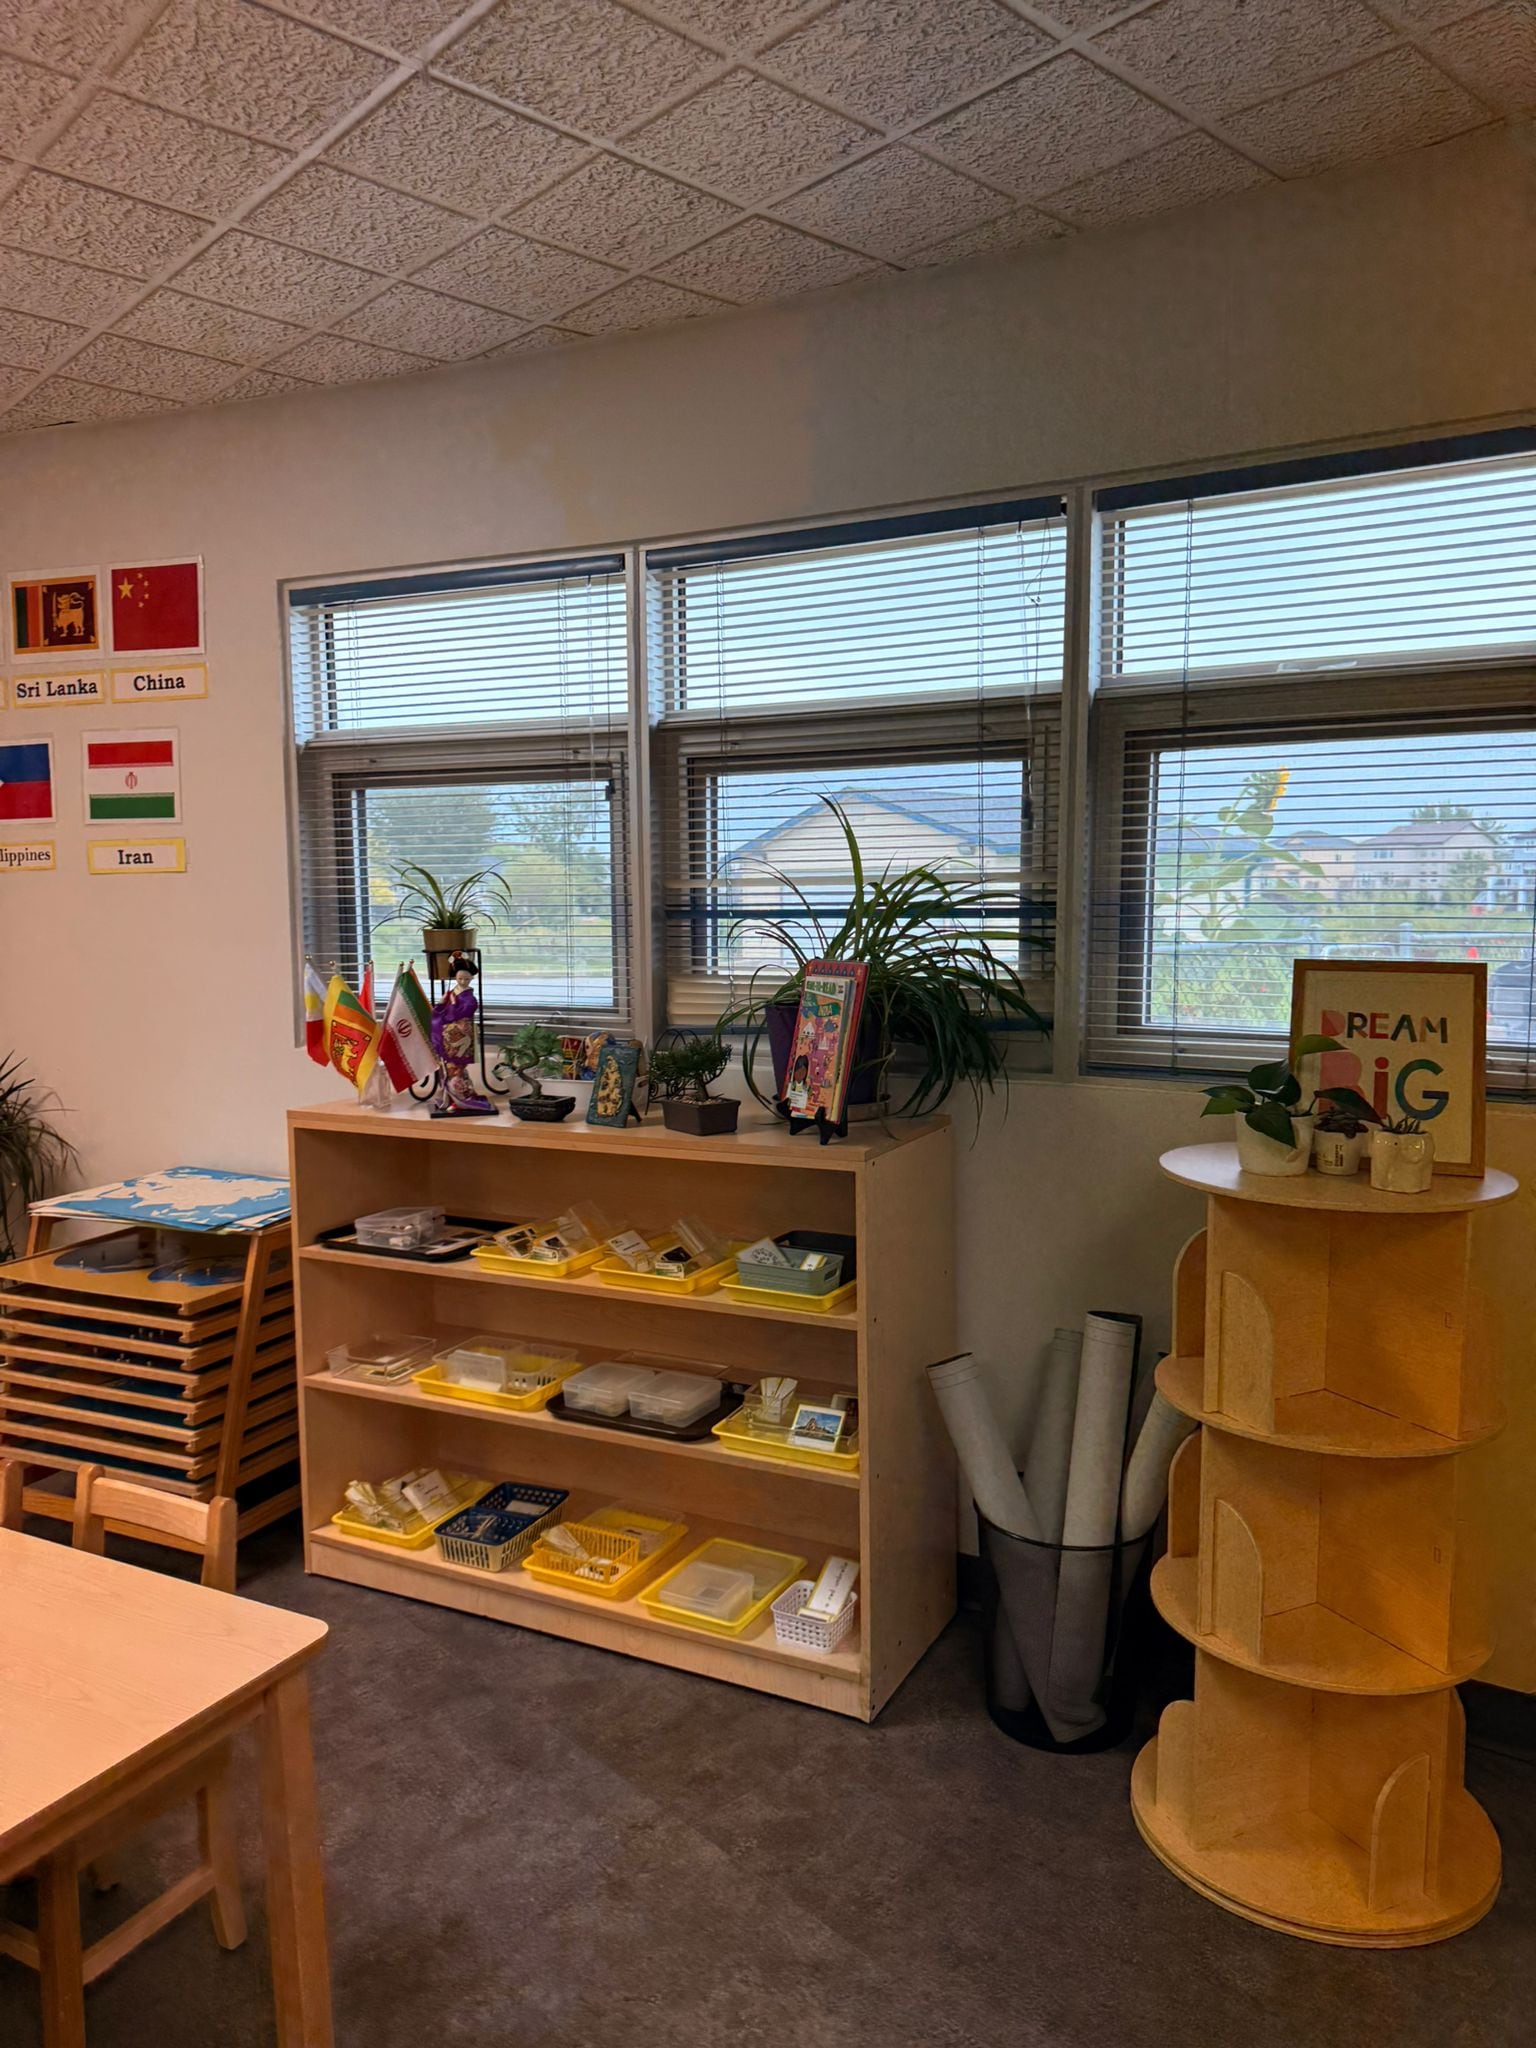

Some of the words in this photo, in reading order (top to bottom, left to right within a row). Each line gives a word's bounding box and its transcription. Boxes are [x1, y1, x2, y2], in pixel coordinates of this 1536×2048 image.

[16, 682, 41, 698] Sri
[46, 678, 98, 696] Lanka
[133, 673, 186, 692] China
[117, 850, 154, 865] Iran
[1321, 1010, 1448, 1043] DREAM
